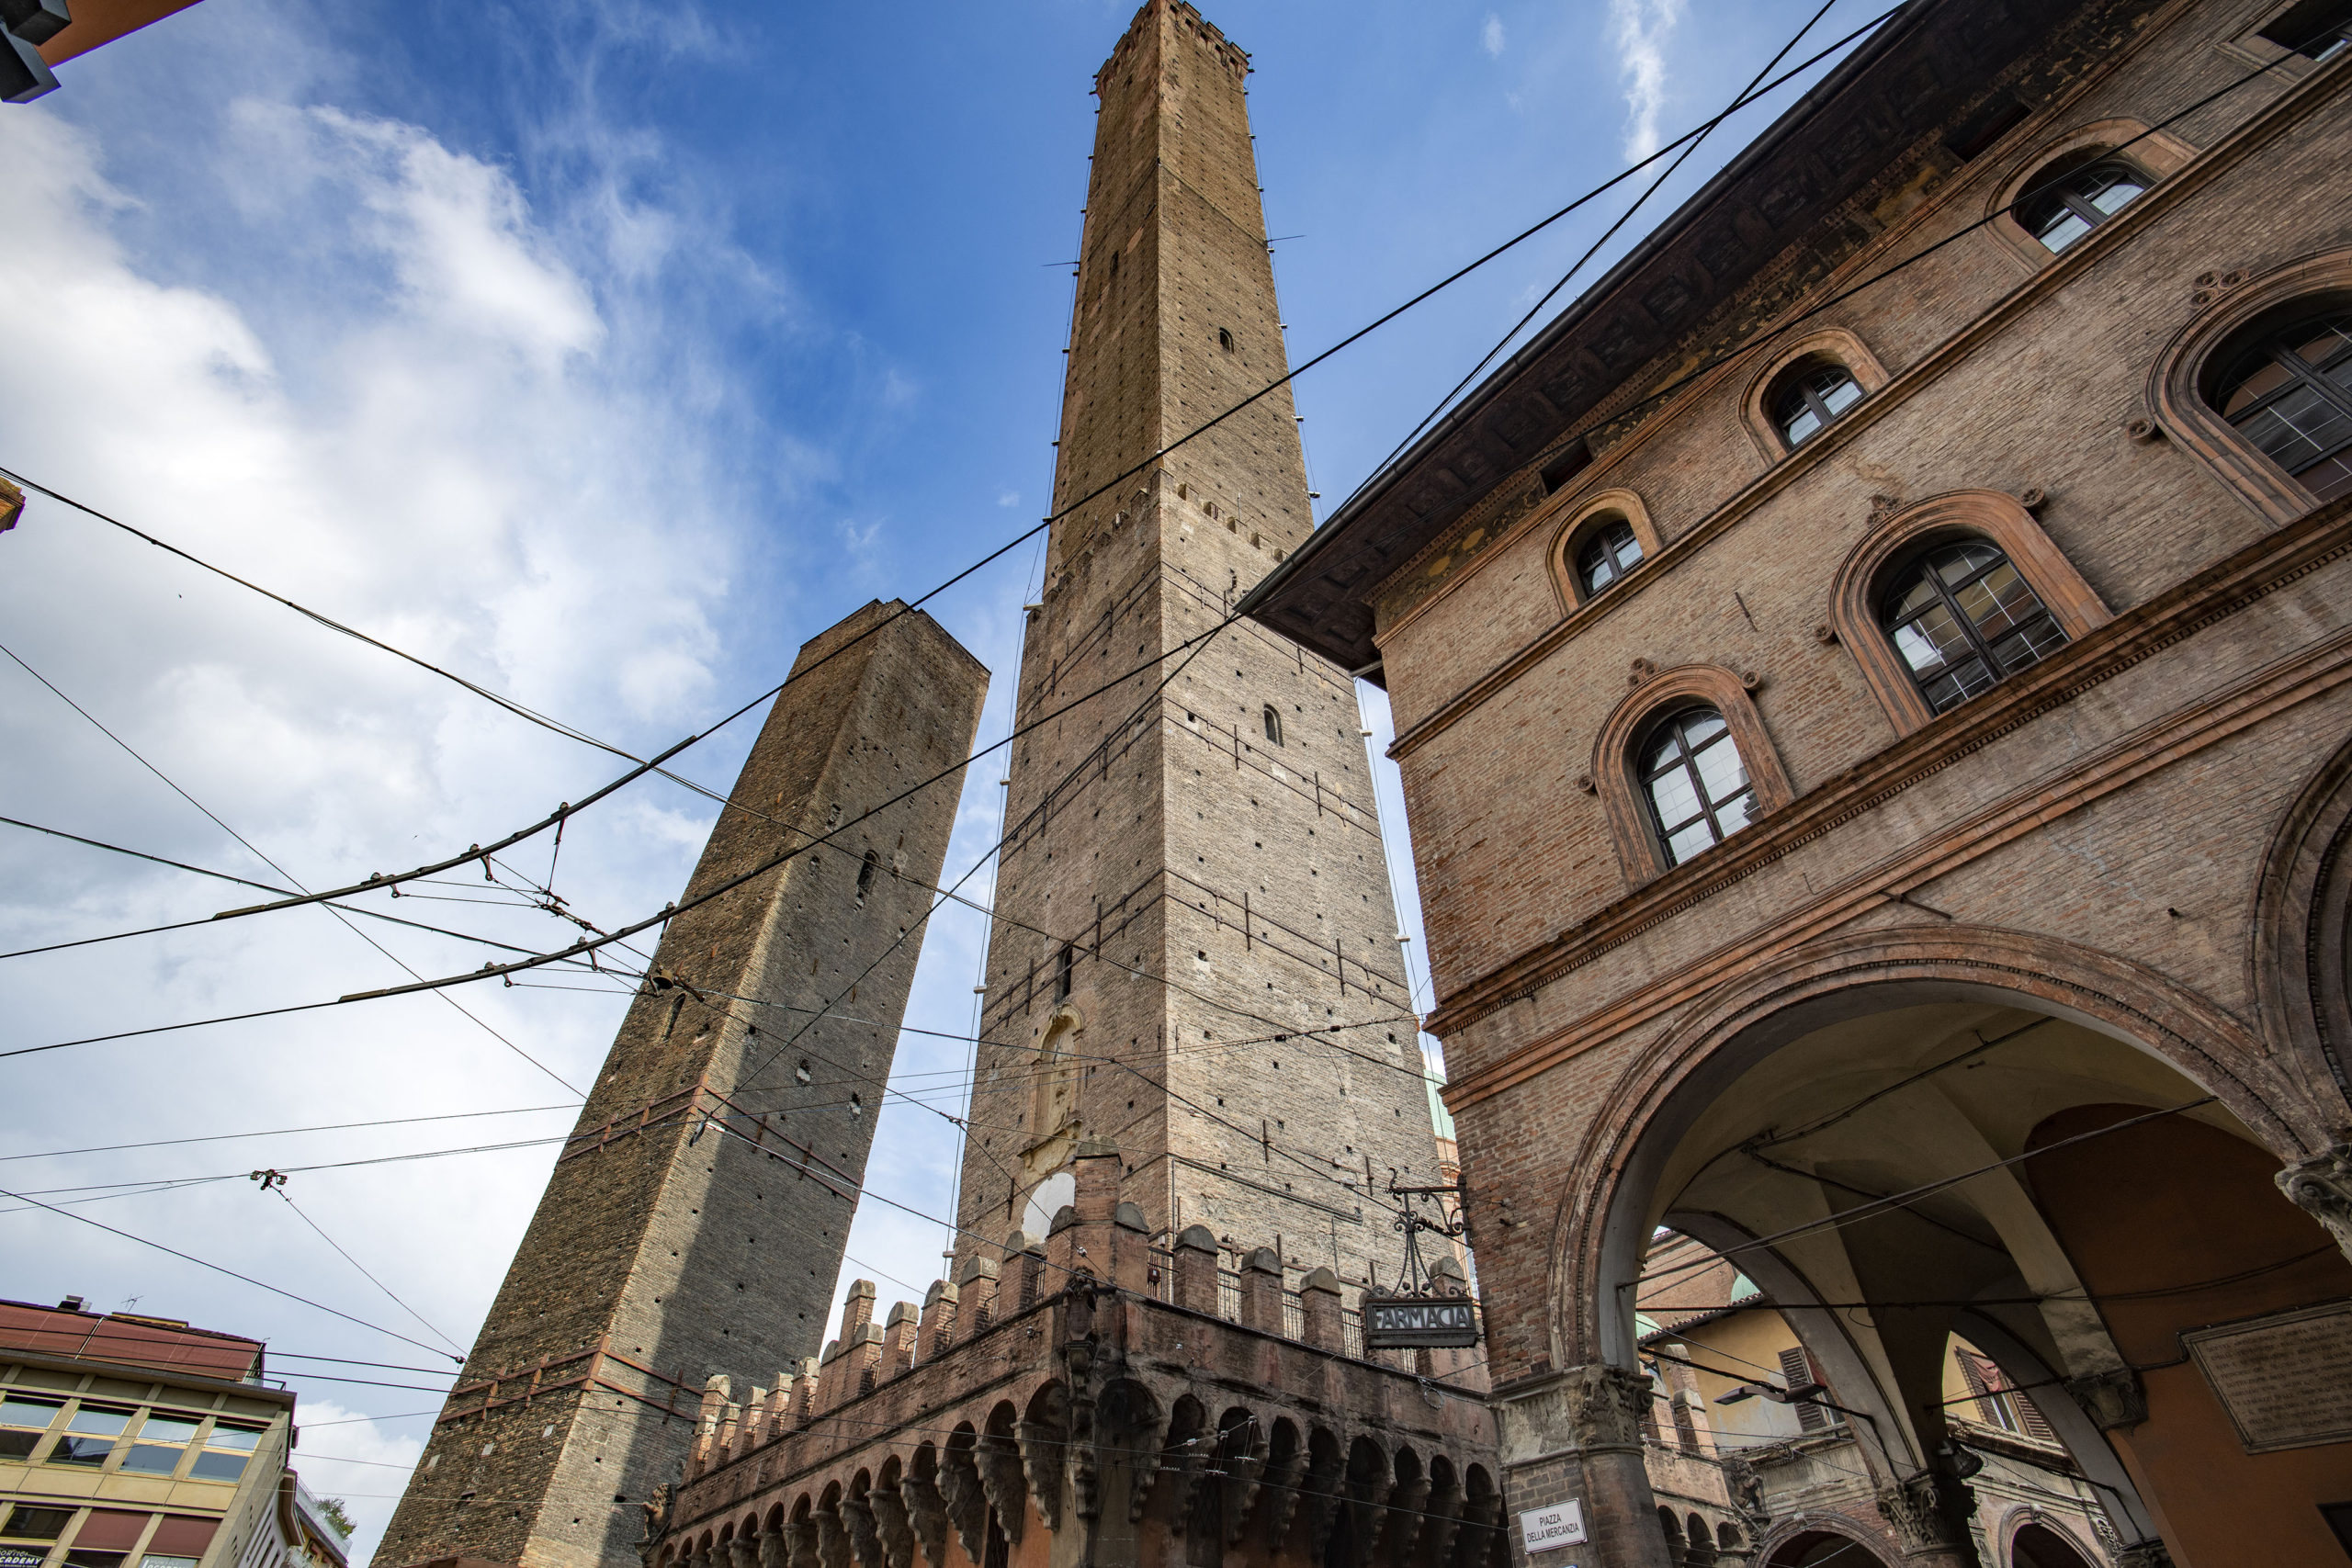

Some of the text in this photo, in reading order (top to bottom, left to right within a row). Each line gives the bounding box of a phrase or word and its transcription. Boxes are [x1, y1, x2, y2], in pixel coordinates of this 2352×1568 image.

[1374, 1306, 1471, 1329] FARMACIA
[1539, 1513, 1562, 1527] PIAZZA
[1526, 1522, 1580, 1543] DELLA MERCANZIA
